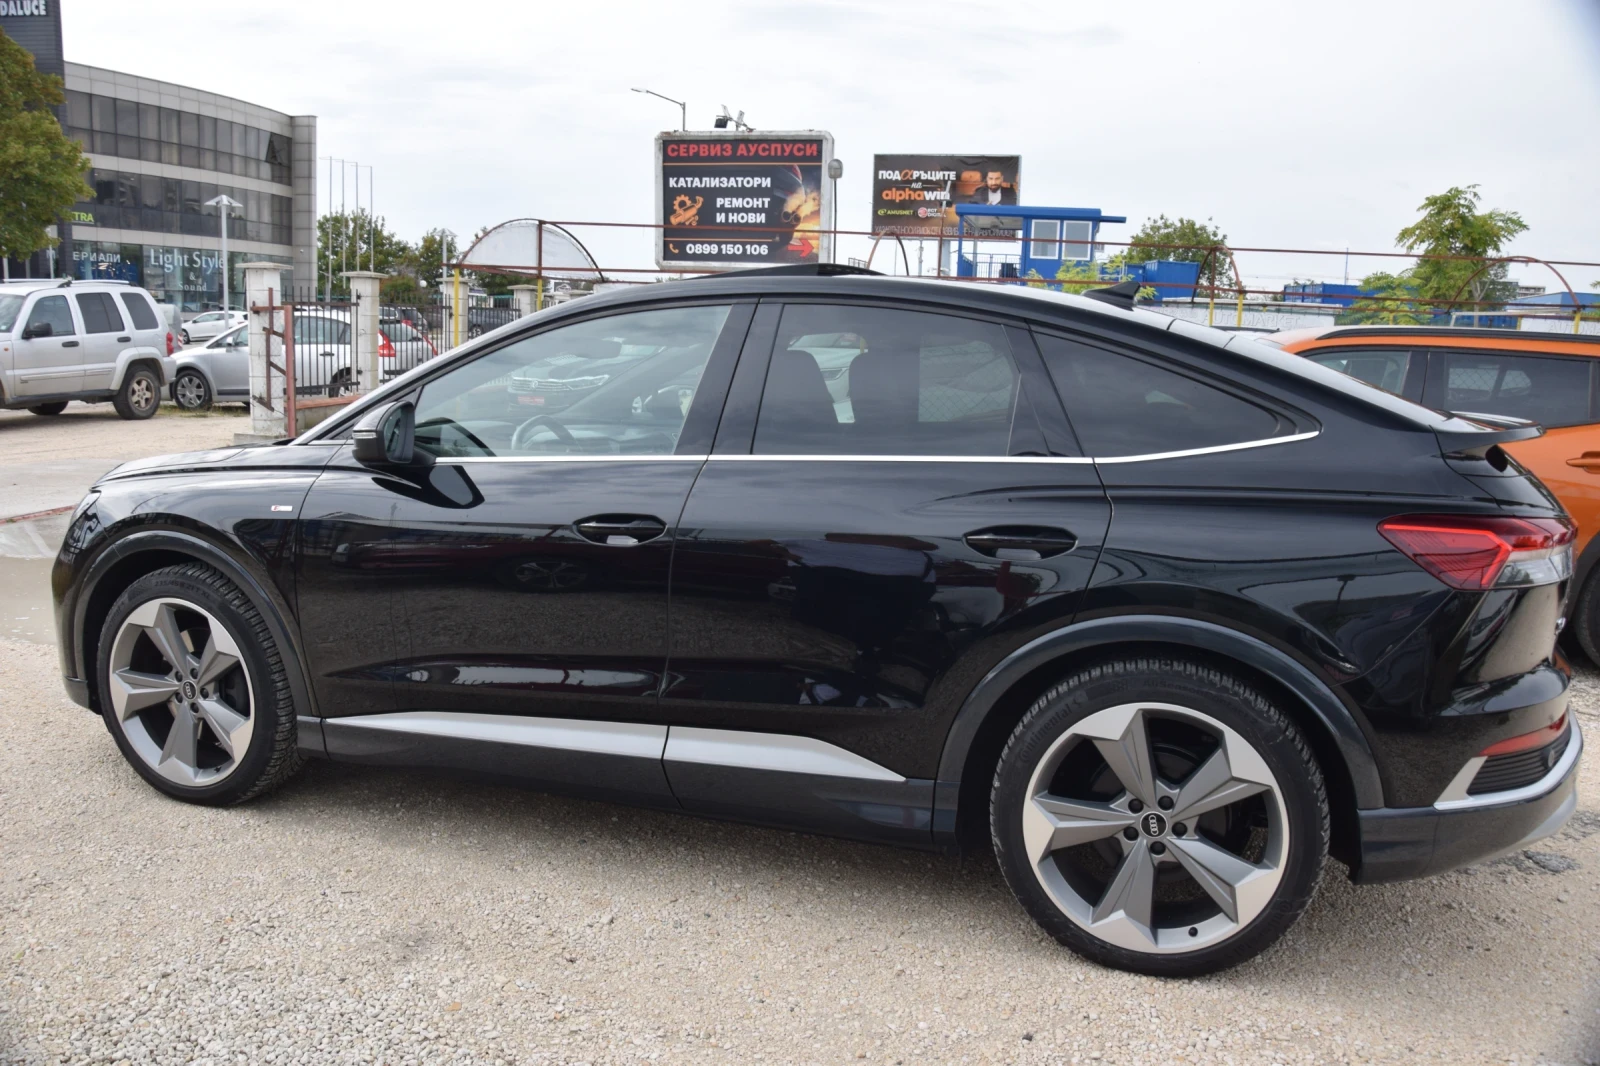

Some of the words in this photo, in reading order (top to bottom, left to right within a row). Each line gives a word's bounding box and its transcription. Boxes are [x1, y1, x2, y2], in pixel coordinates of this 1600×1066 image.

[0, 0, 47, 16] DALUCE
[667, 144, 733, 157] СЕРВИЗ
[736, 143, 818, 157] АУСПУСИ
[669, 177, 771, 188] КАТАЛИЗАТОРИ
[910, 181, 923, 189] на
[881, 187, 950, 203] alphawin
[716, 197, 771, 209] РЕМОНТ
[716, 213, 726, 224] И
[728, 213, 766, 224] НОВИ
[686, 243, 718, 254] 0899
[721, 244, 743, 255] 150
[745, 244, 769, 255] 106
[150, 248, 189, 273] Light
[192, 250, 224, 275] Style
[189, 272, 197, 281] &
[178, 282, 207, 292] Sound
[1018, 702, 1074, 763] Continental
